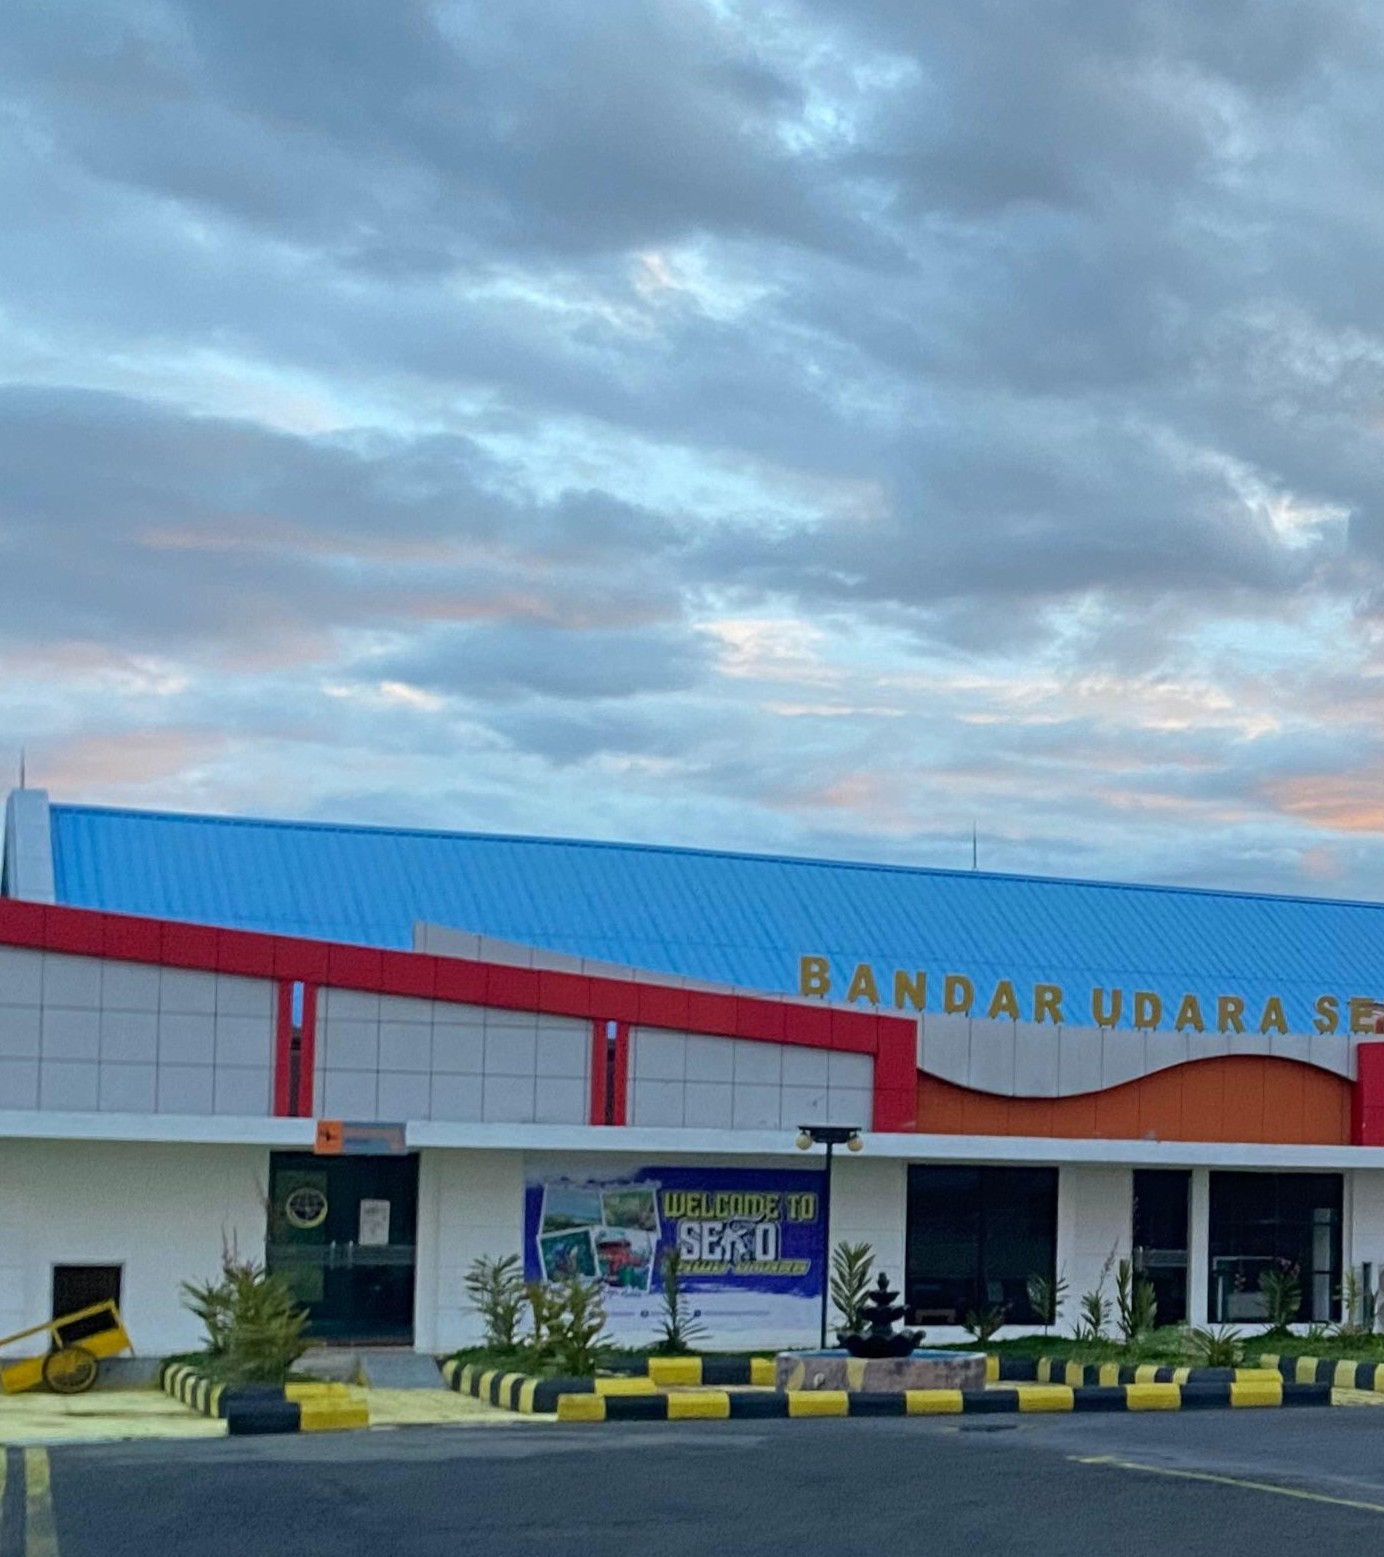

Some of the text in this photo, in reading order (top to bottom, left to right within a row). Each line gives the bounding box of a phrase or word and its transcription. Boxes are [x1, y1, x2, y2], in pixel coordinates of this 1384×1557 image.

[800, 956, 1065, 1024] BANDAR
[1091, 988, 1288, 1034] UDARA
[664, 1192, 815, 1221] WELCOME TO
[680, 1221, 776, 1261] SEKO
